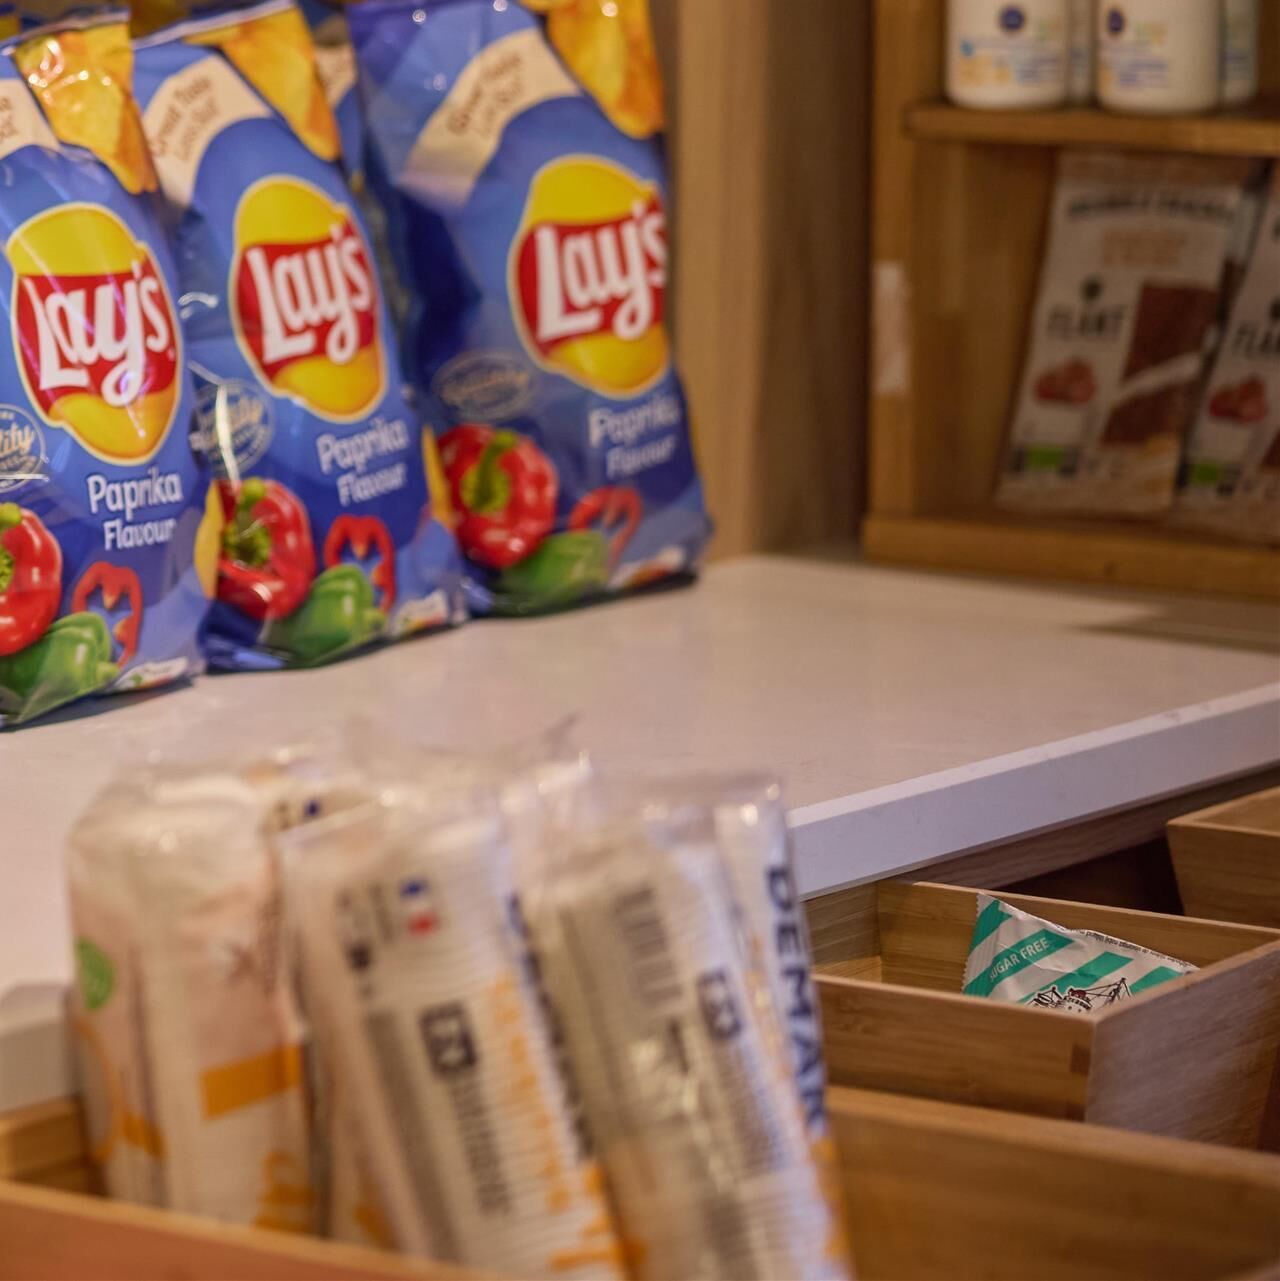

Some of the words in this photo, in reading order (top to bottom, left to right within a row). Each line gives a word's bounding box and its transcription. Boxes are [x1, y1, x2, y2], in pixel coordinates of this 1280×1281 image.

[247, 223, 371, 364] Lay's
[23, 260, 169, 406] Lay's
[87, 468, 183, 520] Paprika
[103, 519, 176, 551] Flavour
[1020, 936, 1051, 959] FREE
